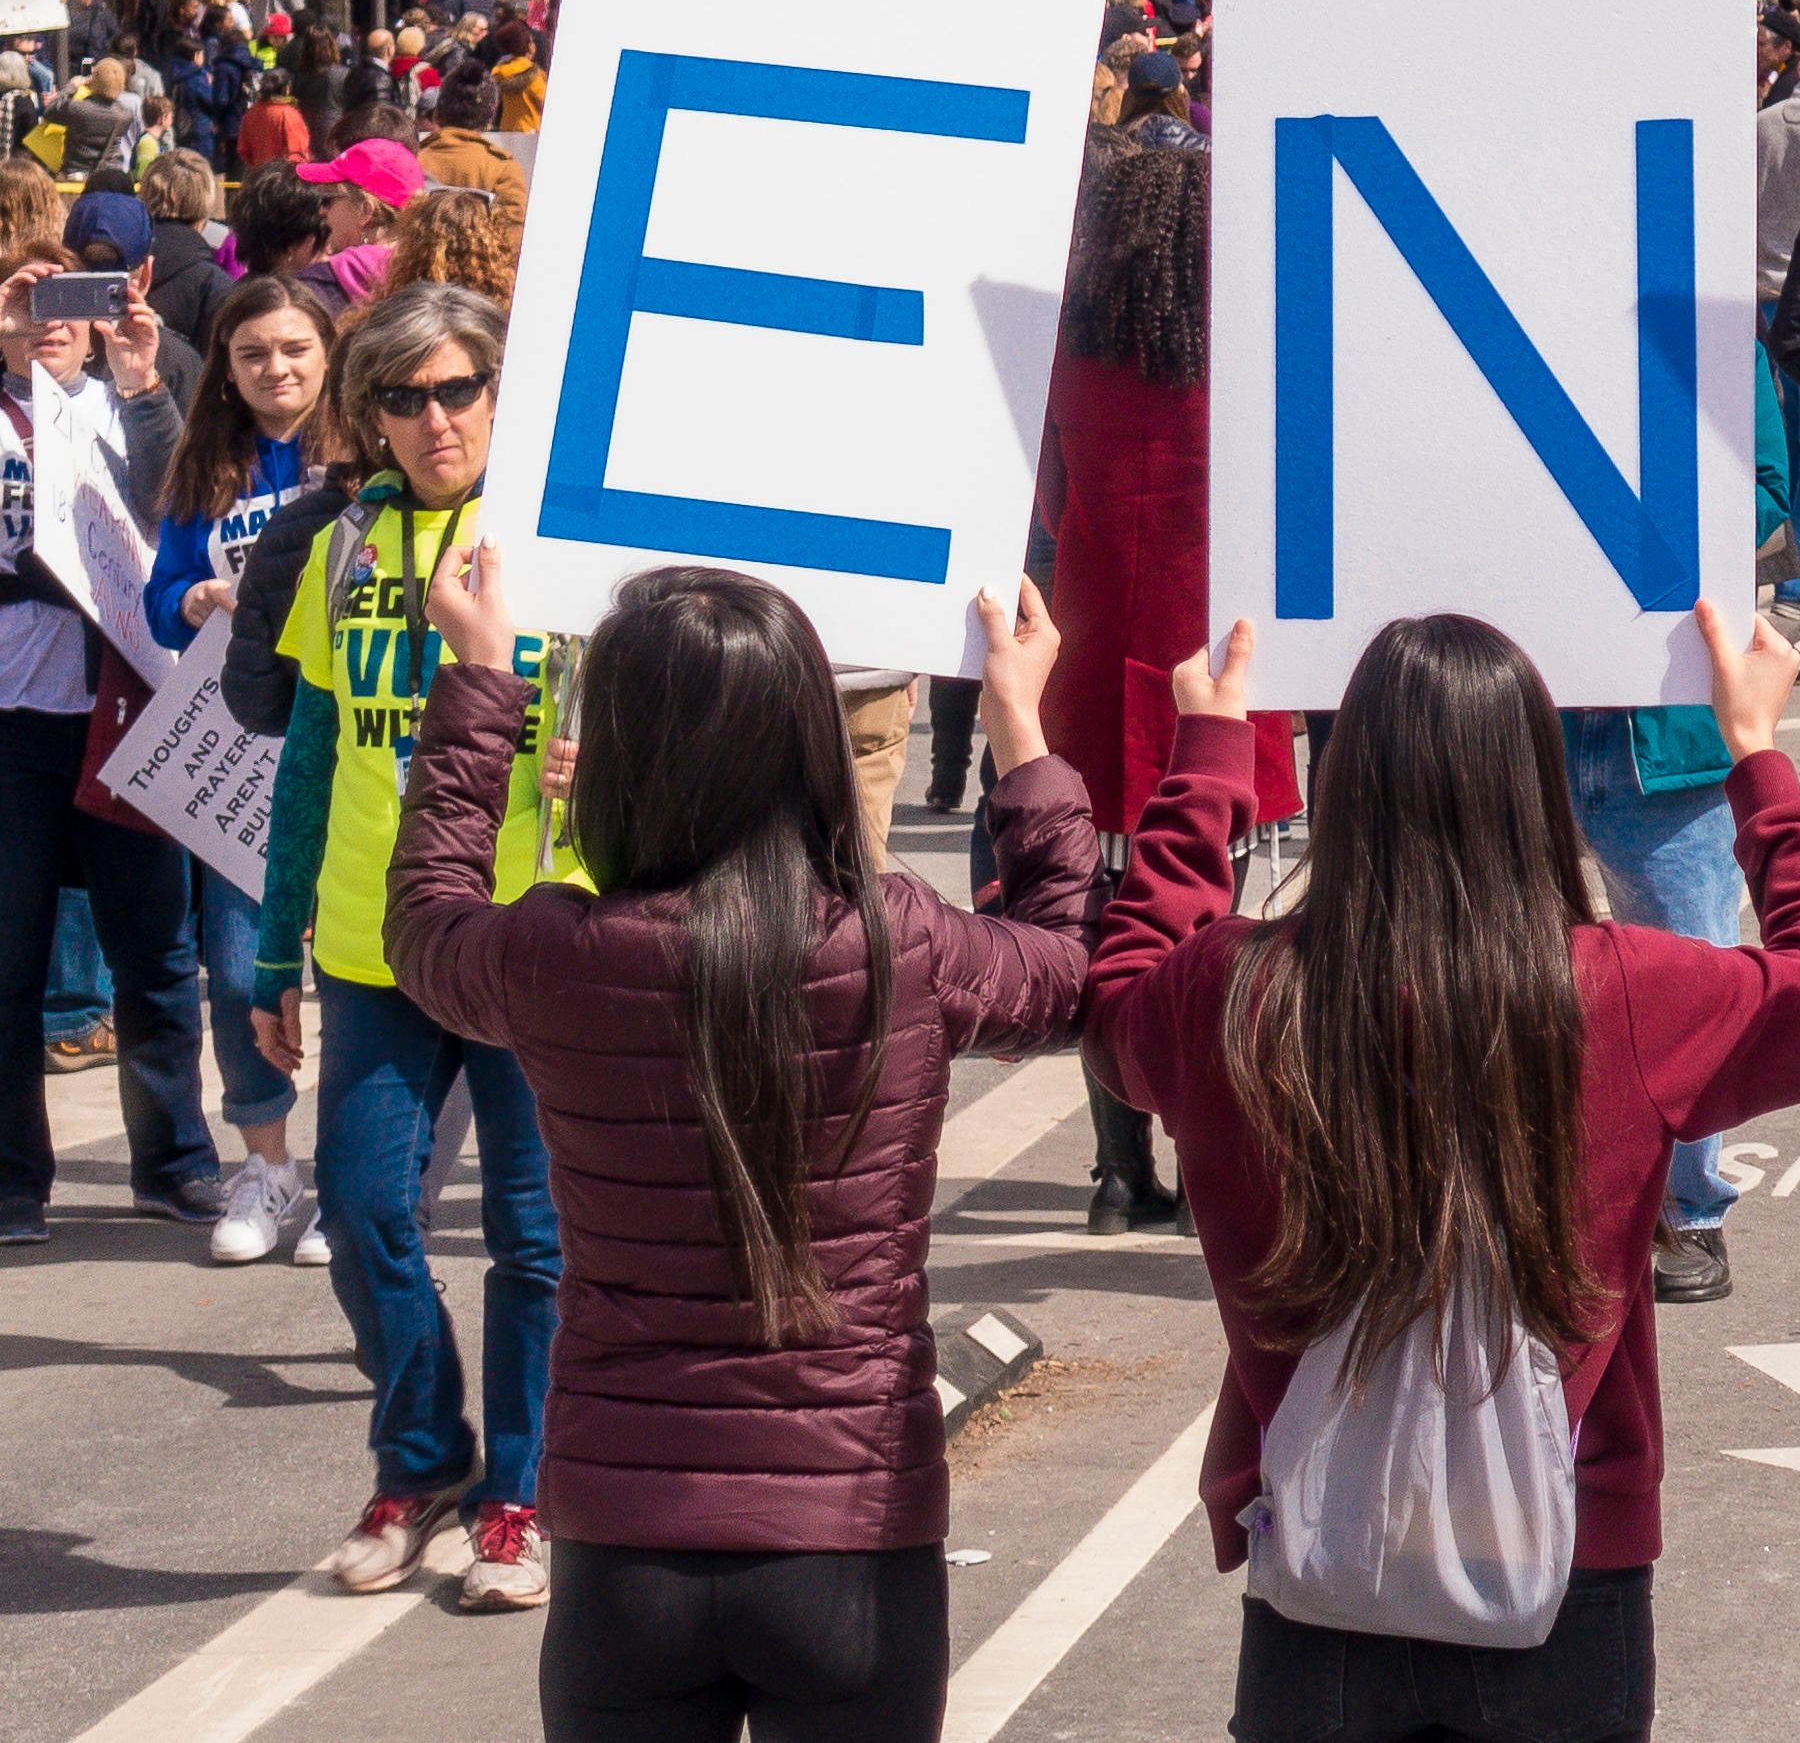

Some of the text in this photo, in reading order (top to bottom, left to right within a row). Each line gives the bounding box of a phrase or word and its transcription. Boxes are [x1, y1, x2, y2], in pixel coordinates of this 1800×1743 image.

[128, 676, 220, 790] THOUGHTS
[184, 729, 220, 780] AND
[214, 749, 276, 835] AREN'T
